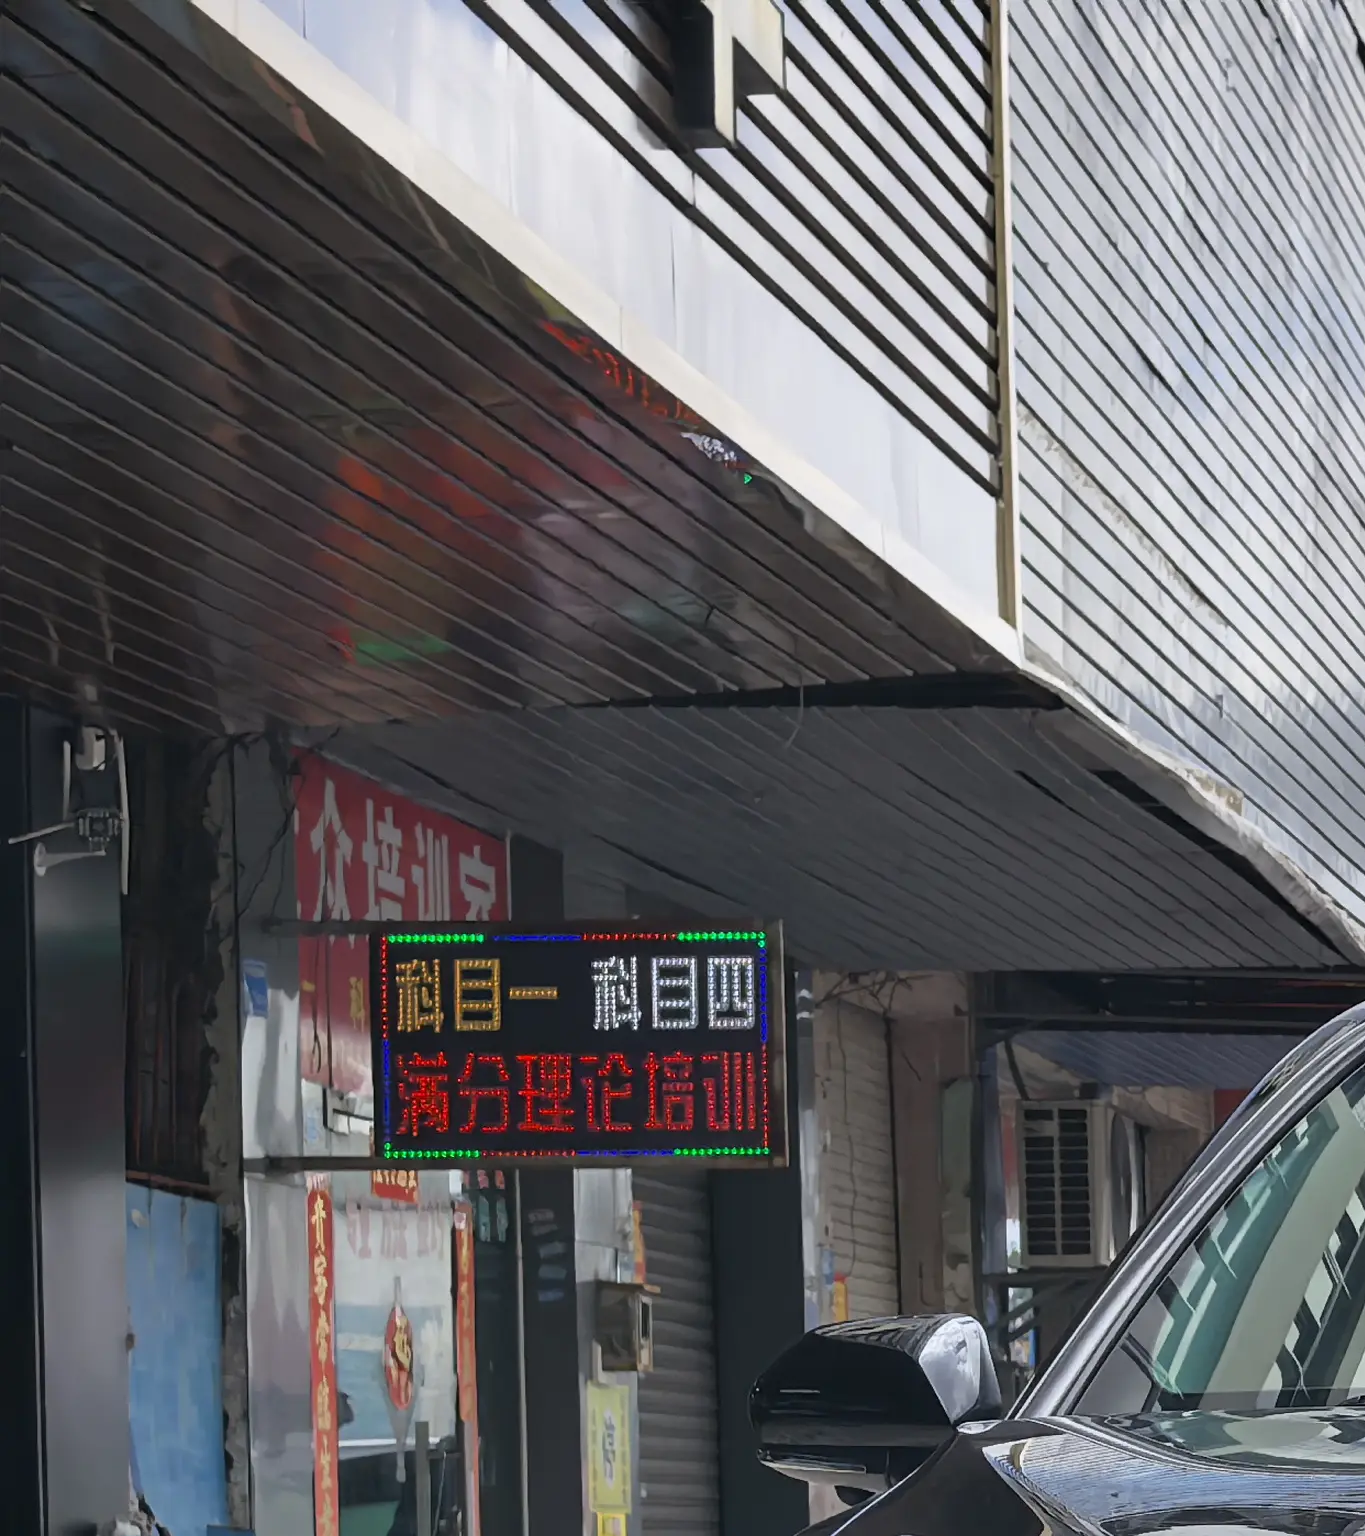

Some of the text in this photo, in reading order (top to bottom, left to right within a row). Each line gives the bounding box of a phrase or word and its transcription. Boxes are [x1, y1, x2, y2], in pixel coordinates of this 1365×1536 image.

[396, 956, 756, 1033] 科目一 科目四
[396, 1050, 757, 1137] 满分理论培训
